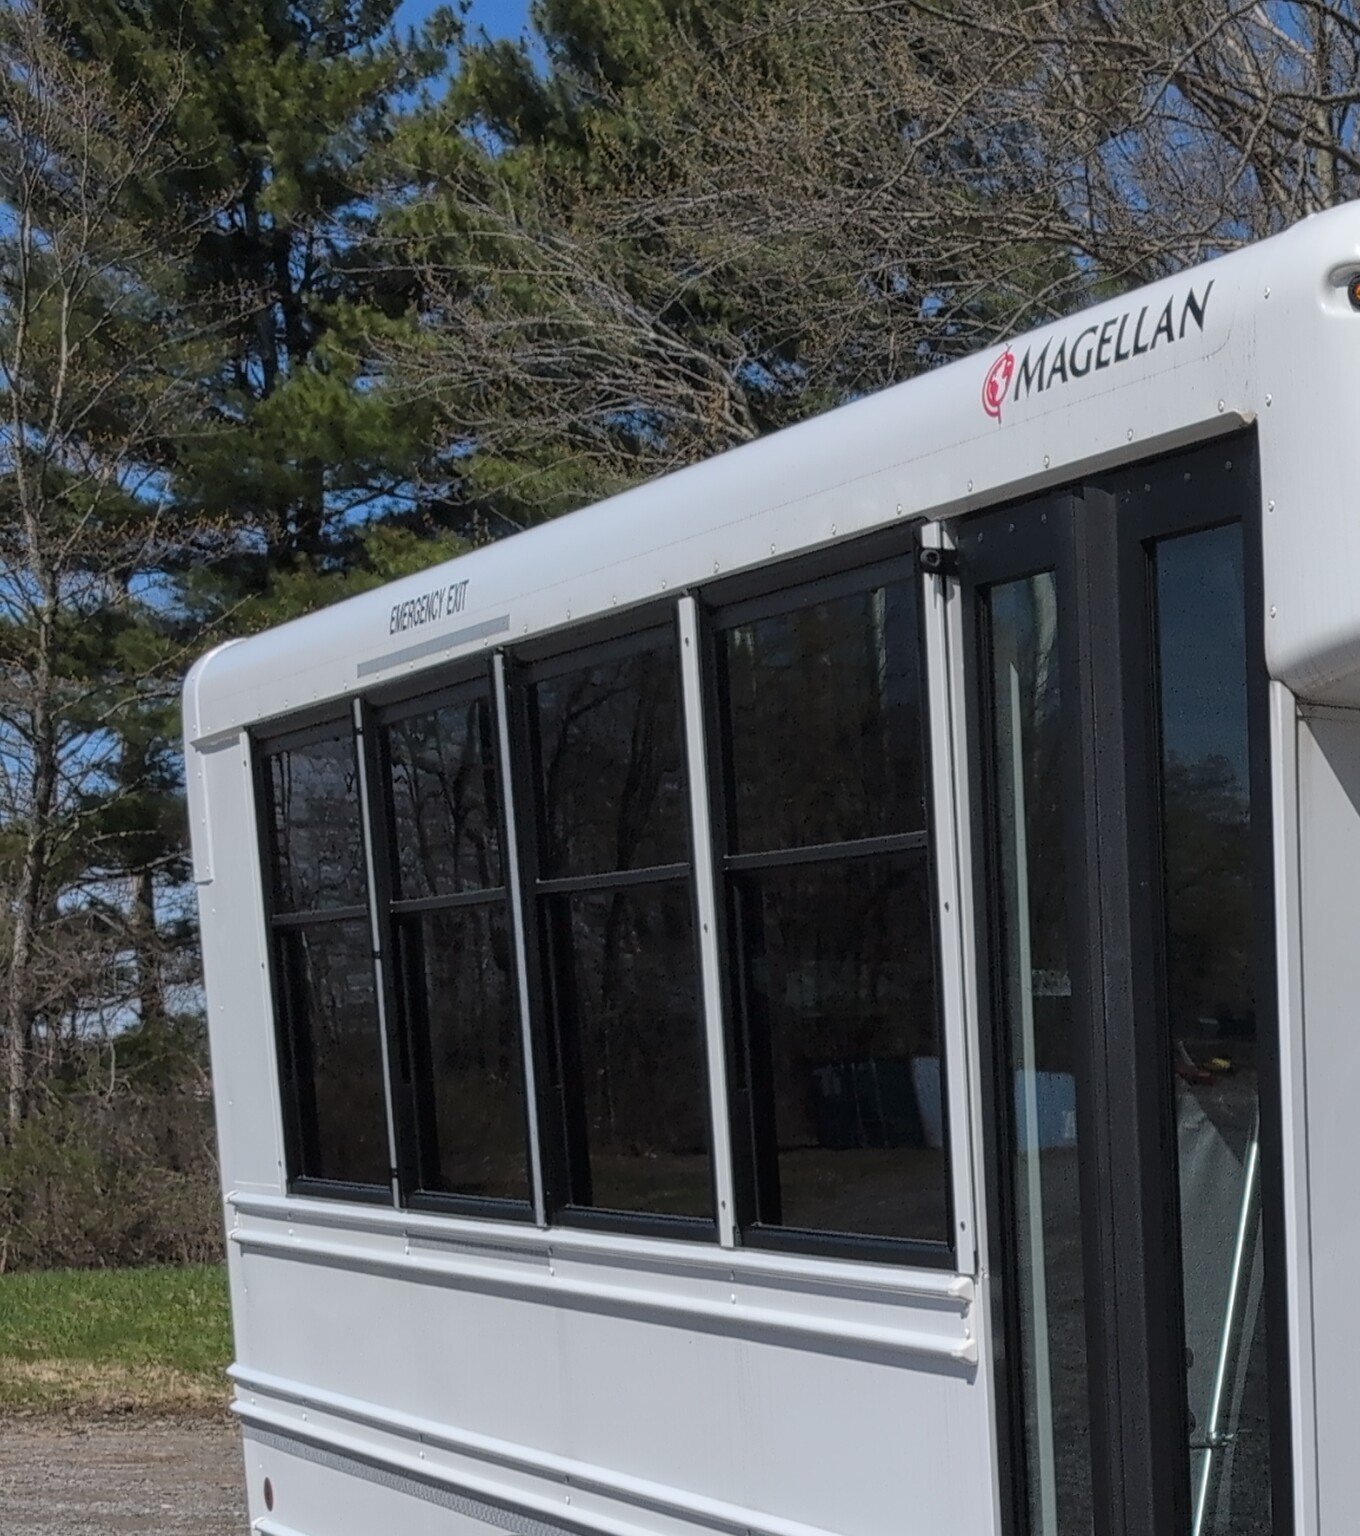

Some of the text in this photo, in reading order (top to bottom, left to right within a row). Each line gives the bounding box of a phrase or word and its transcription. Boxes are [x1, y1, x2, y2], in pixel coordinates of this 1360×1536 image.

[1013, 279, 1215, 402] MAGELLAN
[389, 579, 470, 636] EMERGENCY EXIT
